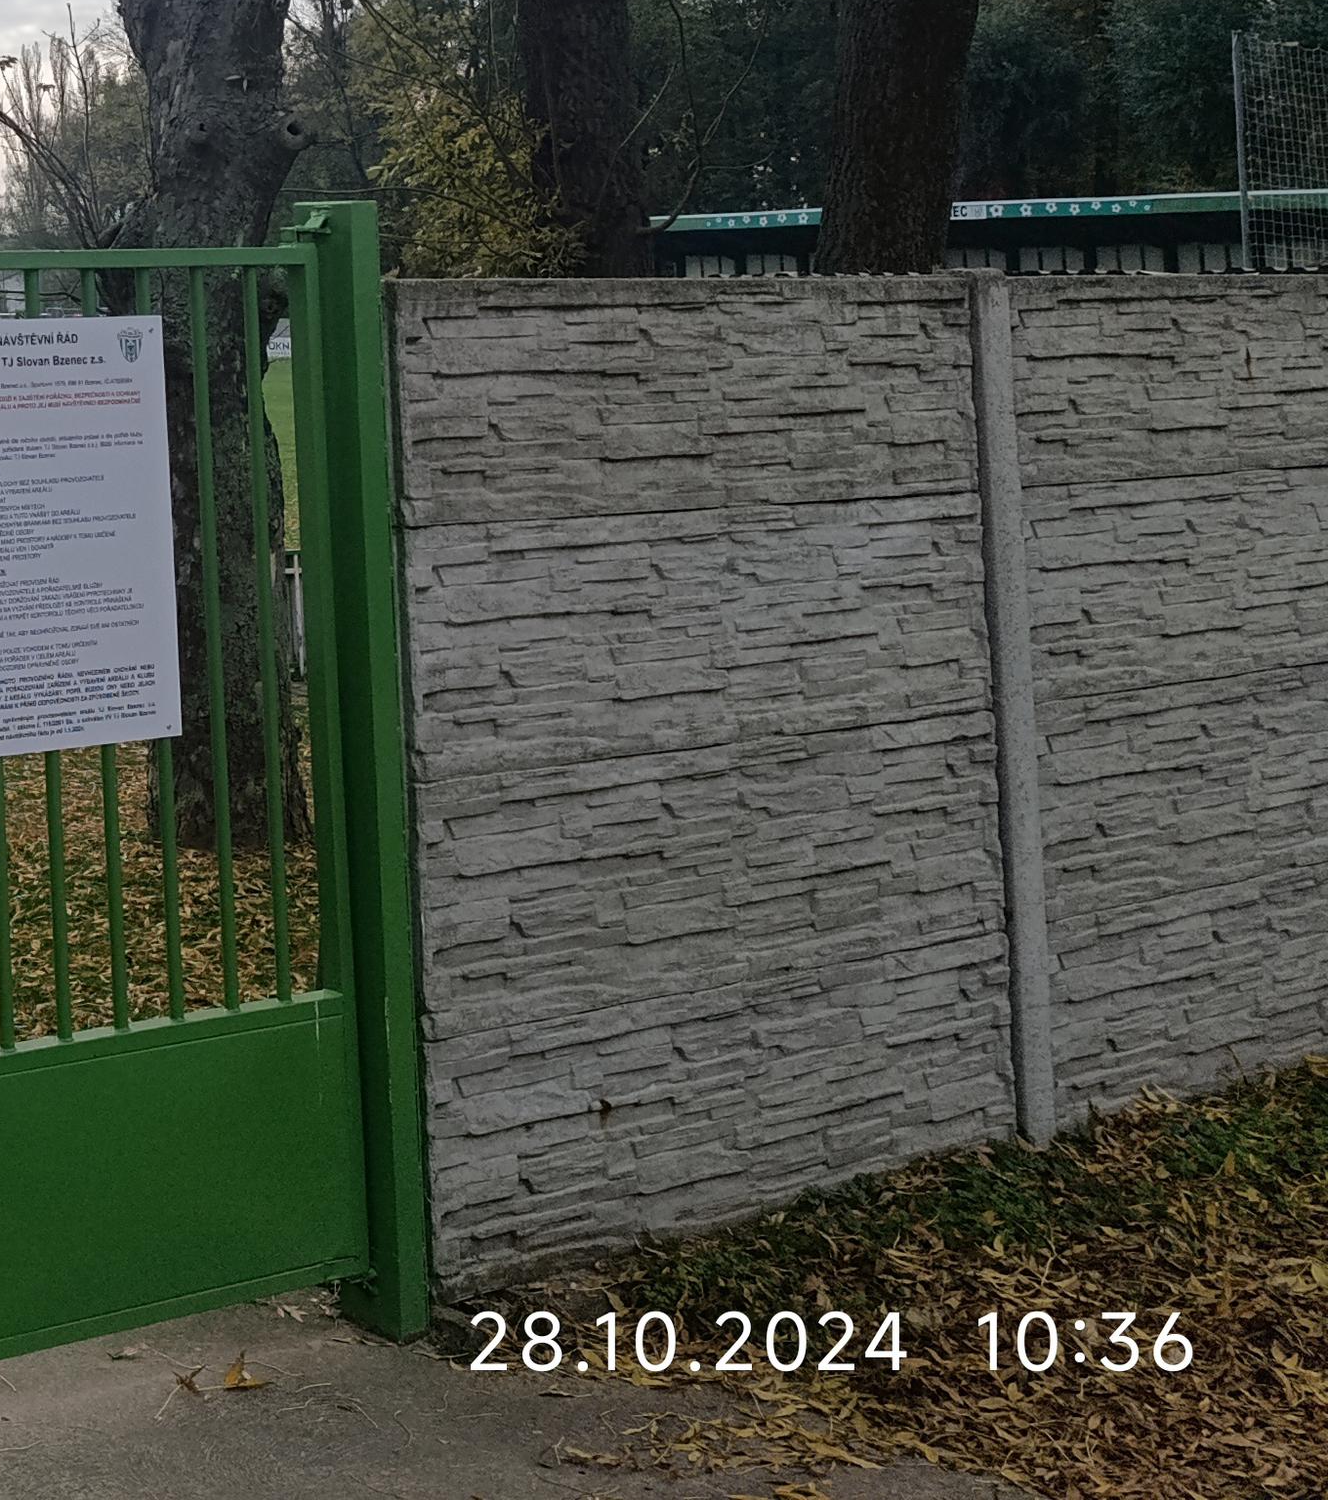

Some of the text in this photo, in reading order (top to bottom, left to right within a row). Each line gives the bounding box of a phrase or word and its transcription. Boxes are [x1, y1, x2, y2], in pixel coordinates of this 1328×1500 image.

[56, 330, 78, 344] ŘÁD
[1, 356, 13, 367] TJ
[16, 355, 50, 367] Slovan
[52, 354, 88, 365] Bzenec
[90, 355, 105, 364] z.s.
